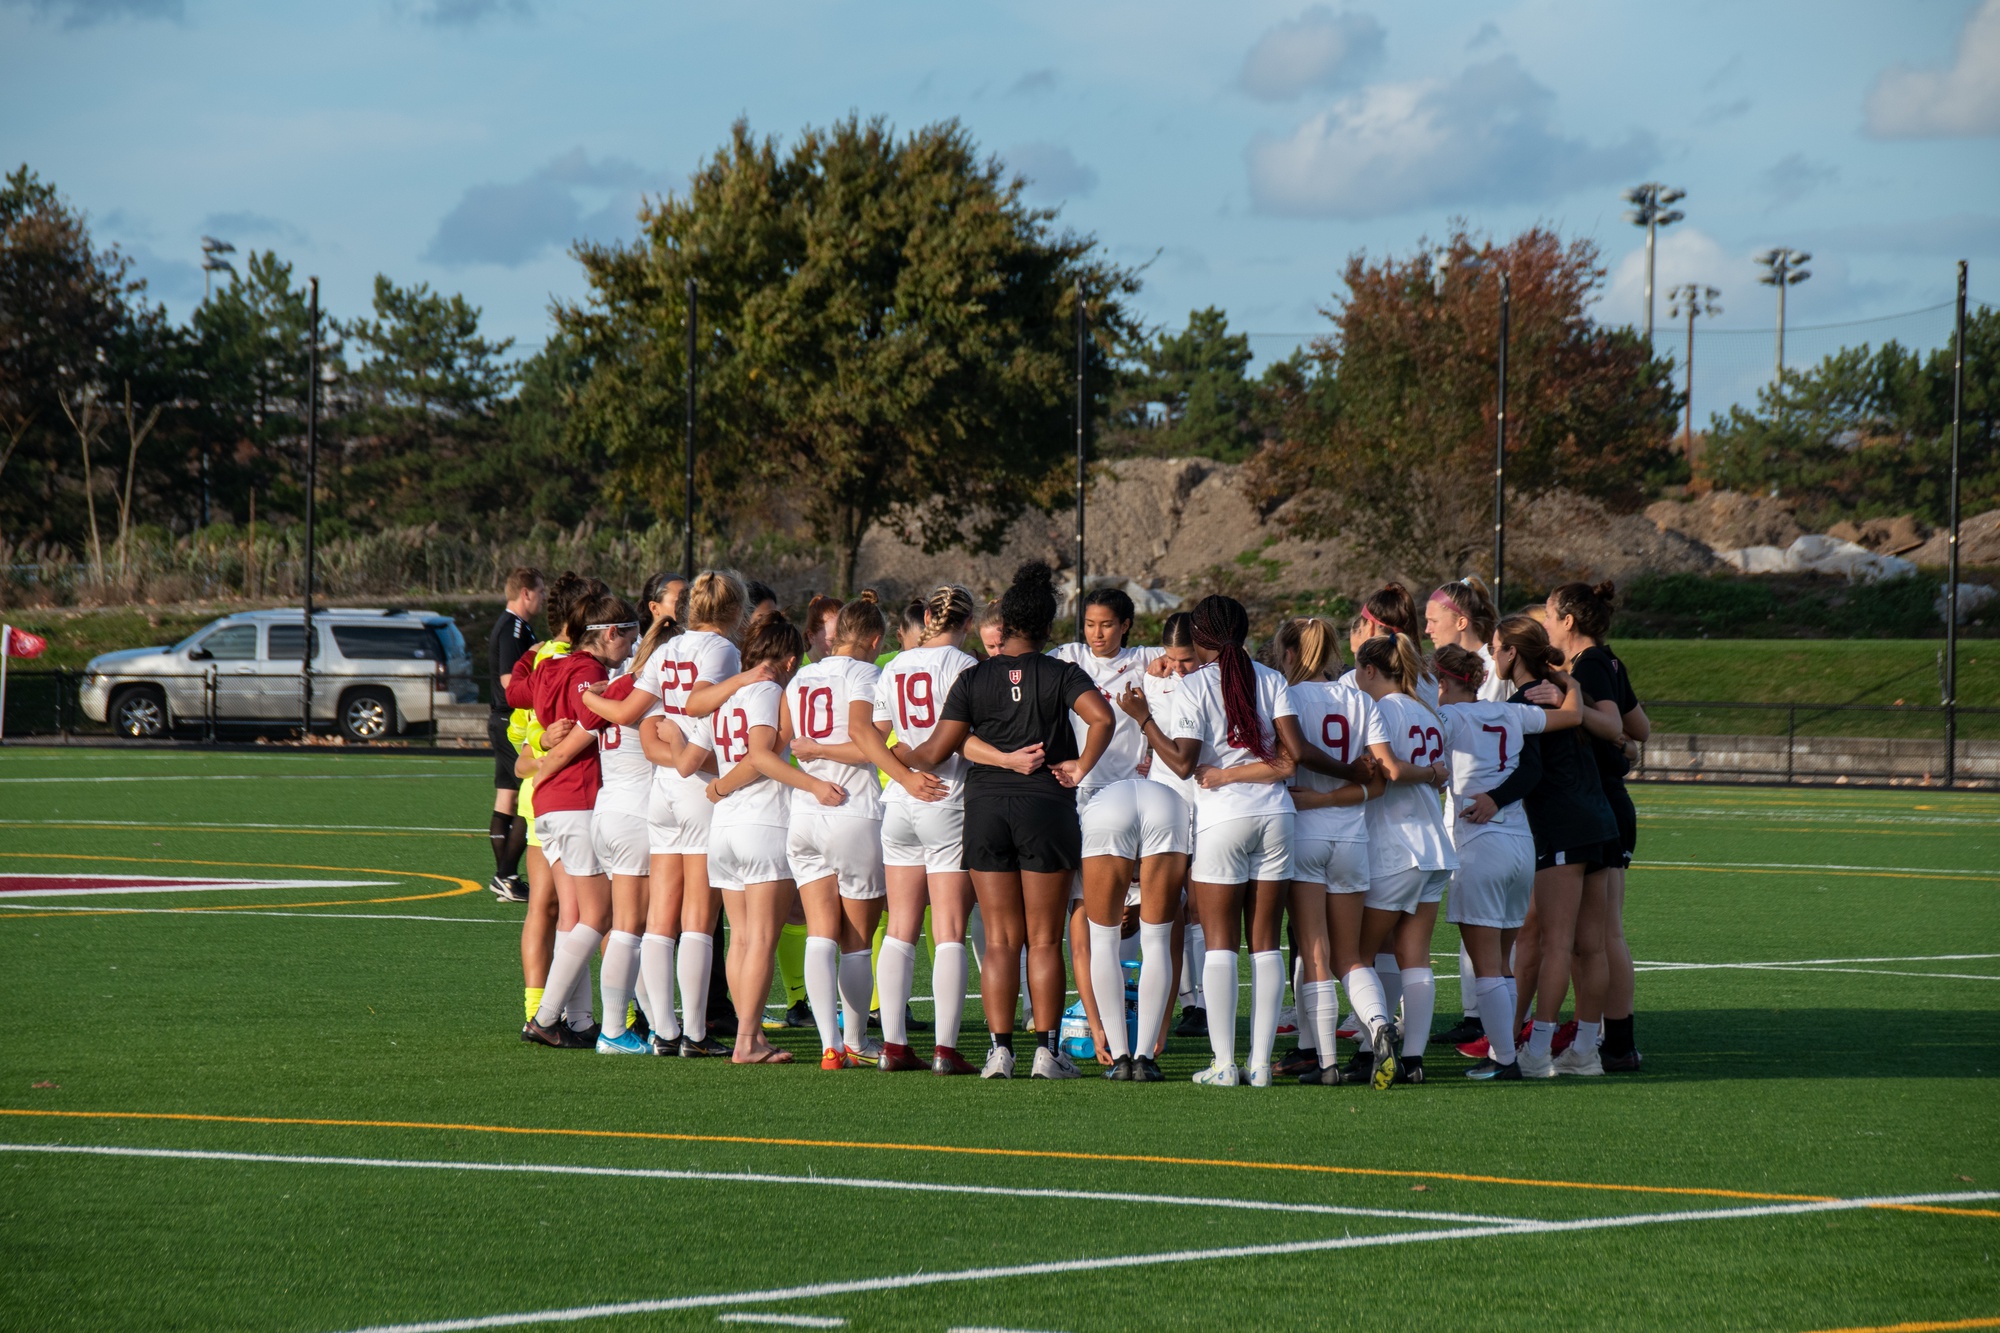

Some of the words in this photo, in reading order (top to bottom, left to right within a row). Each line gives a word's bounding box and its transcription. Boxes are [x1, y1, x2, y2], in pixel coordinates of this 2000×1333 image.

[578, 681, 590, 693] 24
[895, 672, 935, 730] 19
[1011, 686, 1021, 702] 0
[713, 708, 749, 762] 43
[798, 686, 833, 738] 10
[1322, 714, 1349, 764] 9
[1409, 725, 1443, 764] 22
[1482, 724, 1508, 772] 7
